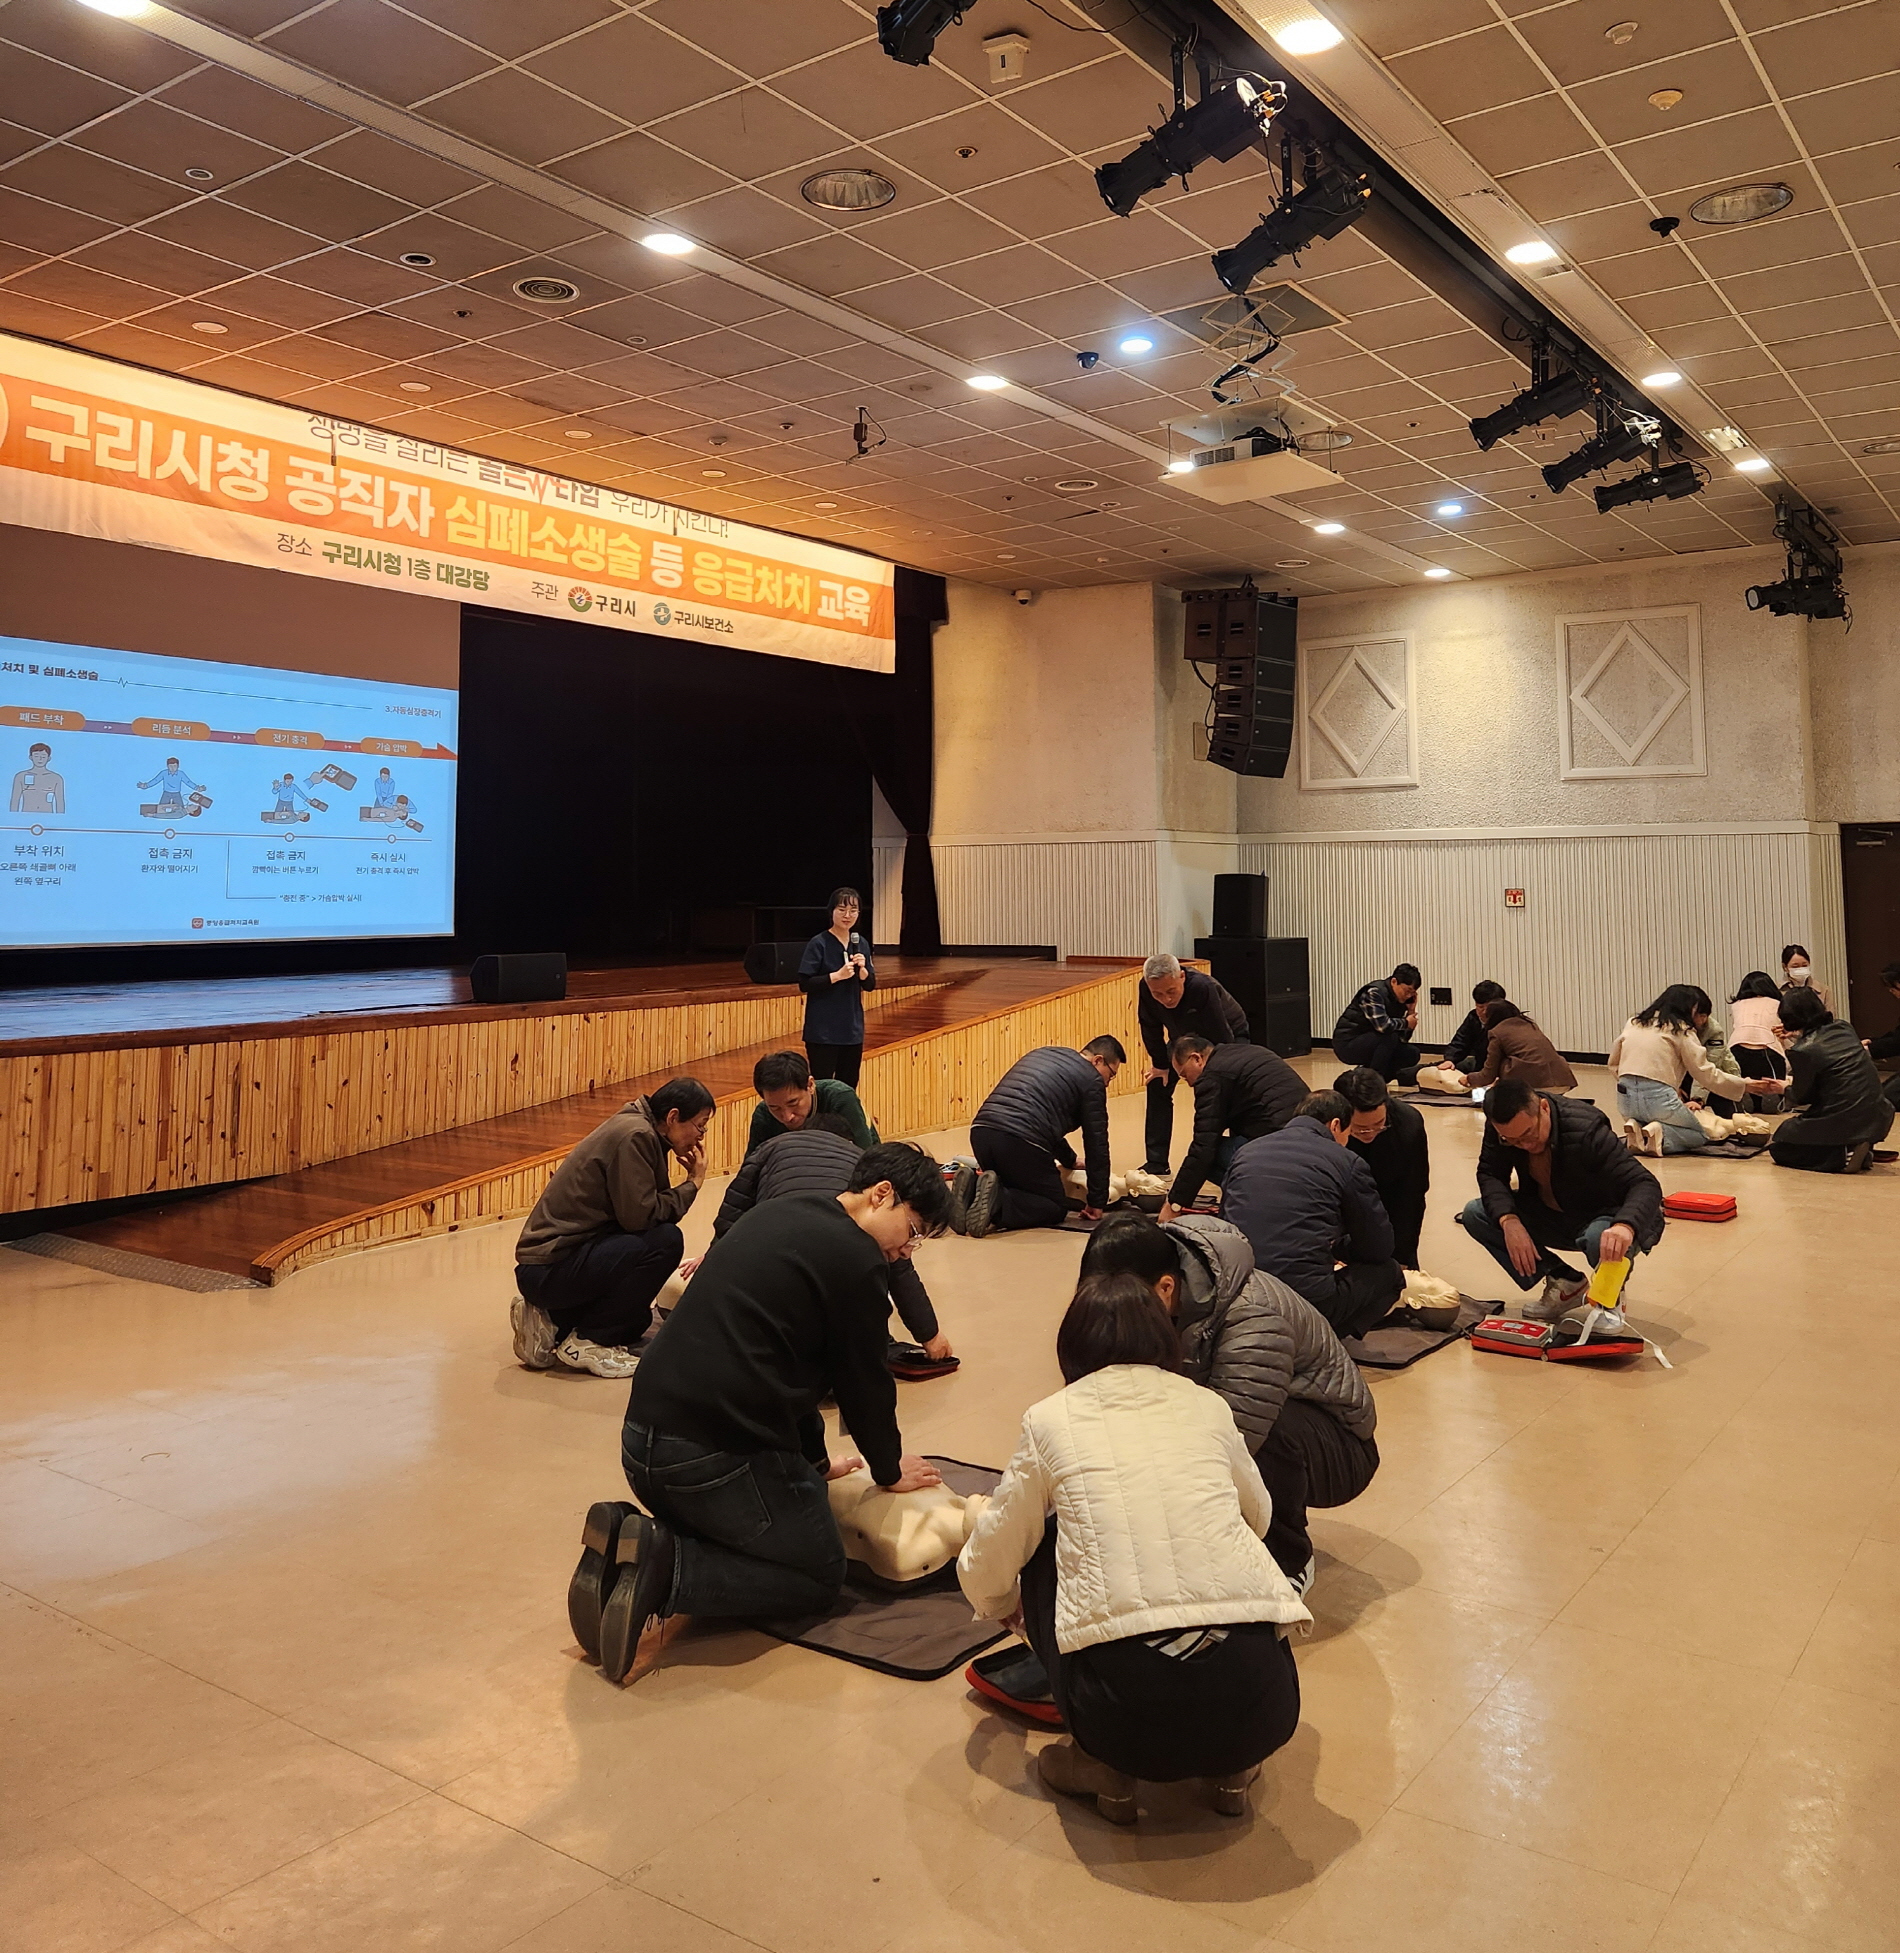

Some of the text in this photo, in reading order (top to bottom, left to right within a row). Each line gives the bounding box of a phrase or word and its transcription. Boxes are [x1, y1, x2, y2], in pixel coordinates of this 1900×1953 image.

[25, 395, 871, 627] 구리시청 공직자 심폐소생술 등 응급처치 교육
[611, 492, 668, 524] 우리가
[277, 533, 490, 591] 장소 구리시청 1층 대강당
[531, 581, 559, 601] 주관
[596, 595, 636, 617] 구리시
[674, 611, 734, 633] 구리시보건소
[28, 664, 39, 675] 및
[43, 666, 99, 681] 심폐소생술
[19, 712, 64, 725] 패드 부착
[152, 723, 191, 736] 리듬 분석
[273, 733, 308, 745] 전기 충격
[376, 742, 407, 753] 가슴 압박
[14, 845, 64, 857] 부착 위치
[148, 847, 193, 859] 접촉 금지
[266, 850, 306, 861] 접촉 금지
[371, 852, 406, 862] 즉시 실시
[0, 862, 28, 871] 오른쪽
[58, 863, 76, 872] 아래
[141, 864, 198, 873] 환자와 떨어지기
[14, 877, 61, 886] 왼쪽 옆구리
